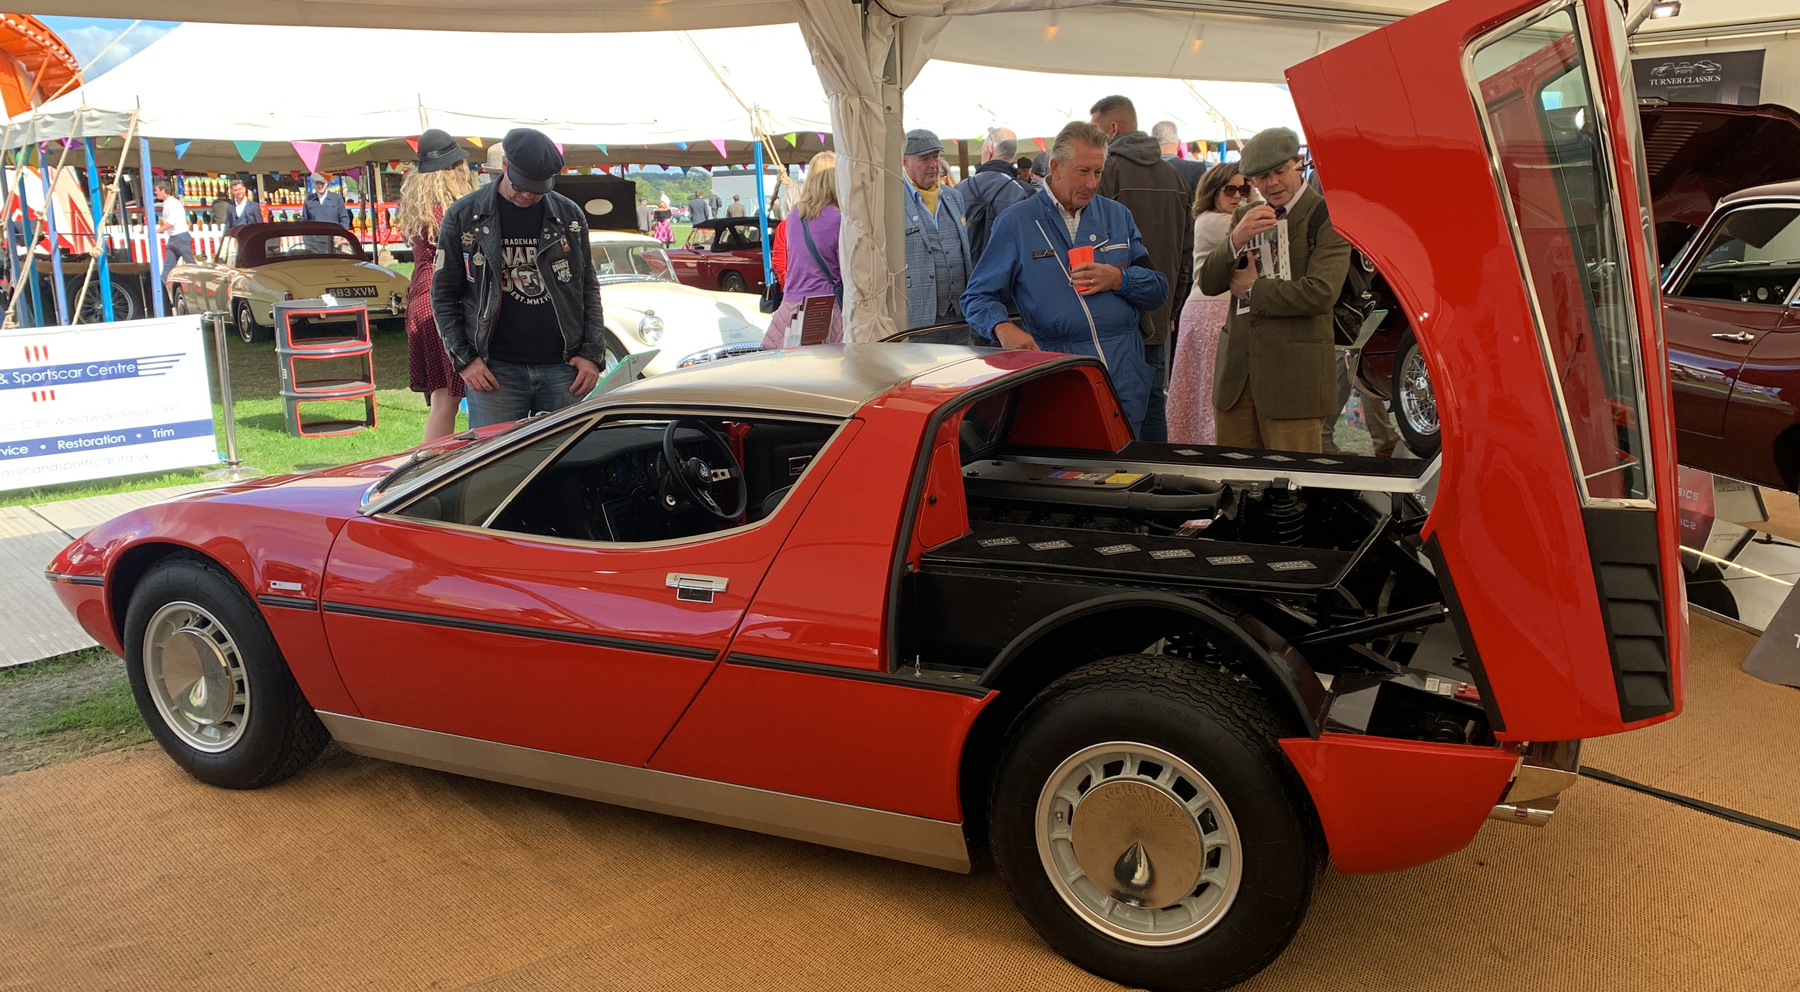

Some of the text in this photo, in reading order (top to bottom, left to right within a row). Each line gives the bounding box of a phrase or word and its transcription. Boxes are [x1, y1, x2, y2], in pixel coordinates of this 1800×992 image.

[1650, 75, 1721, 86] TURNER CLASSICS
[353, 287, 376, 297] XVM
[0, 362, 136, 385] & Sportscar Centre
[22, 418, 50, 430] Cars
[122, 407, 152, 419] Since
[158, 403, 180, 415] 1991
[0, 427, 175, 456] vice Restoration Trim
[1127, 697, 1200, 730] MICHELIN
